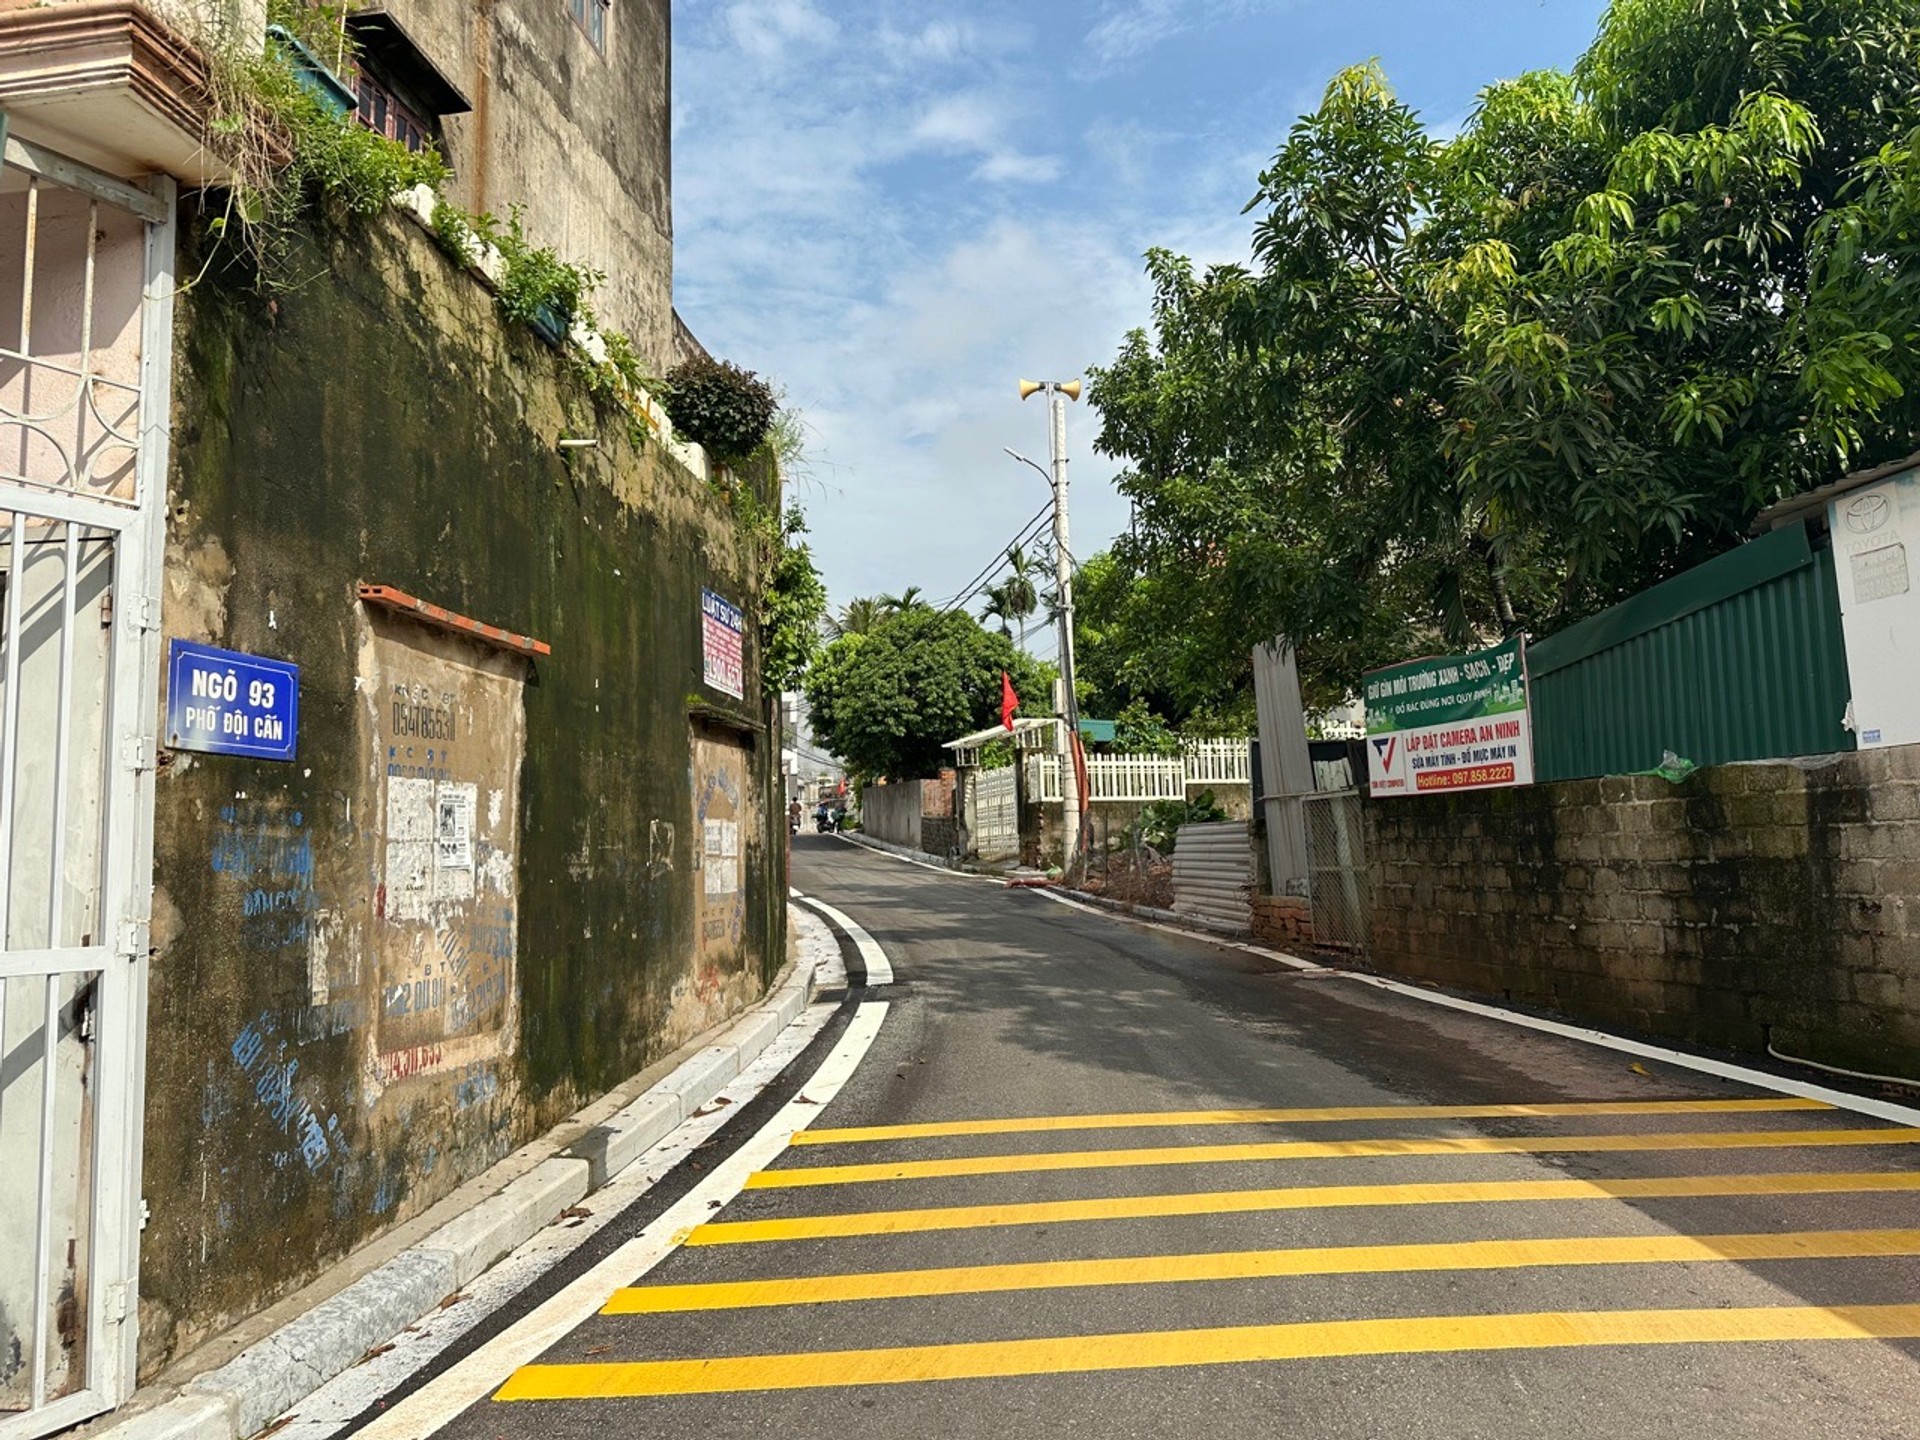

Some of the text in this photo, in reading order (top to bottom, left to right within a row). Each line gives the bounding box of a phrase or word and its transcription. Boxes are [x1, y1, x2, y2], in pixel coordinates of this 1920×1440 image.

[1844, 529, 1900, 553] TOYOTA
[1438, 666, 1459, 686] XANH
[1463, 659, 1491, 683] SẠCH
[1496, 652, 1515, 675] ĐẸP
[192, 669, 275, 708] NGÕ 93
[1456, 691, 1473, 704] QUY
[185, 705, 283, 741] PHỐ ĐỘI CẤN
[1406, 720, 1520, 753] LẮP ĐẶT CAMERA AN NINH
[1461, 746, 1471, 763] ĐỔ
[1472, 747, 1489, 764] MỰC
[1490, 744, 1506, 760] MÁY
[1507, 745, 1517, 757] IN
[1417, 766, 1512, 787] Hotline: 097.858.2227
